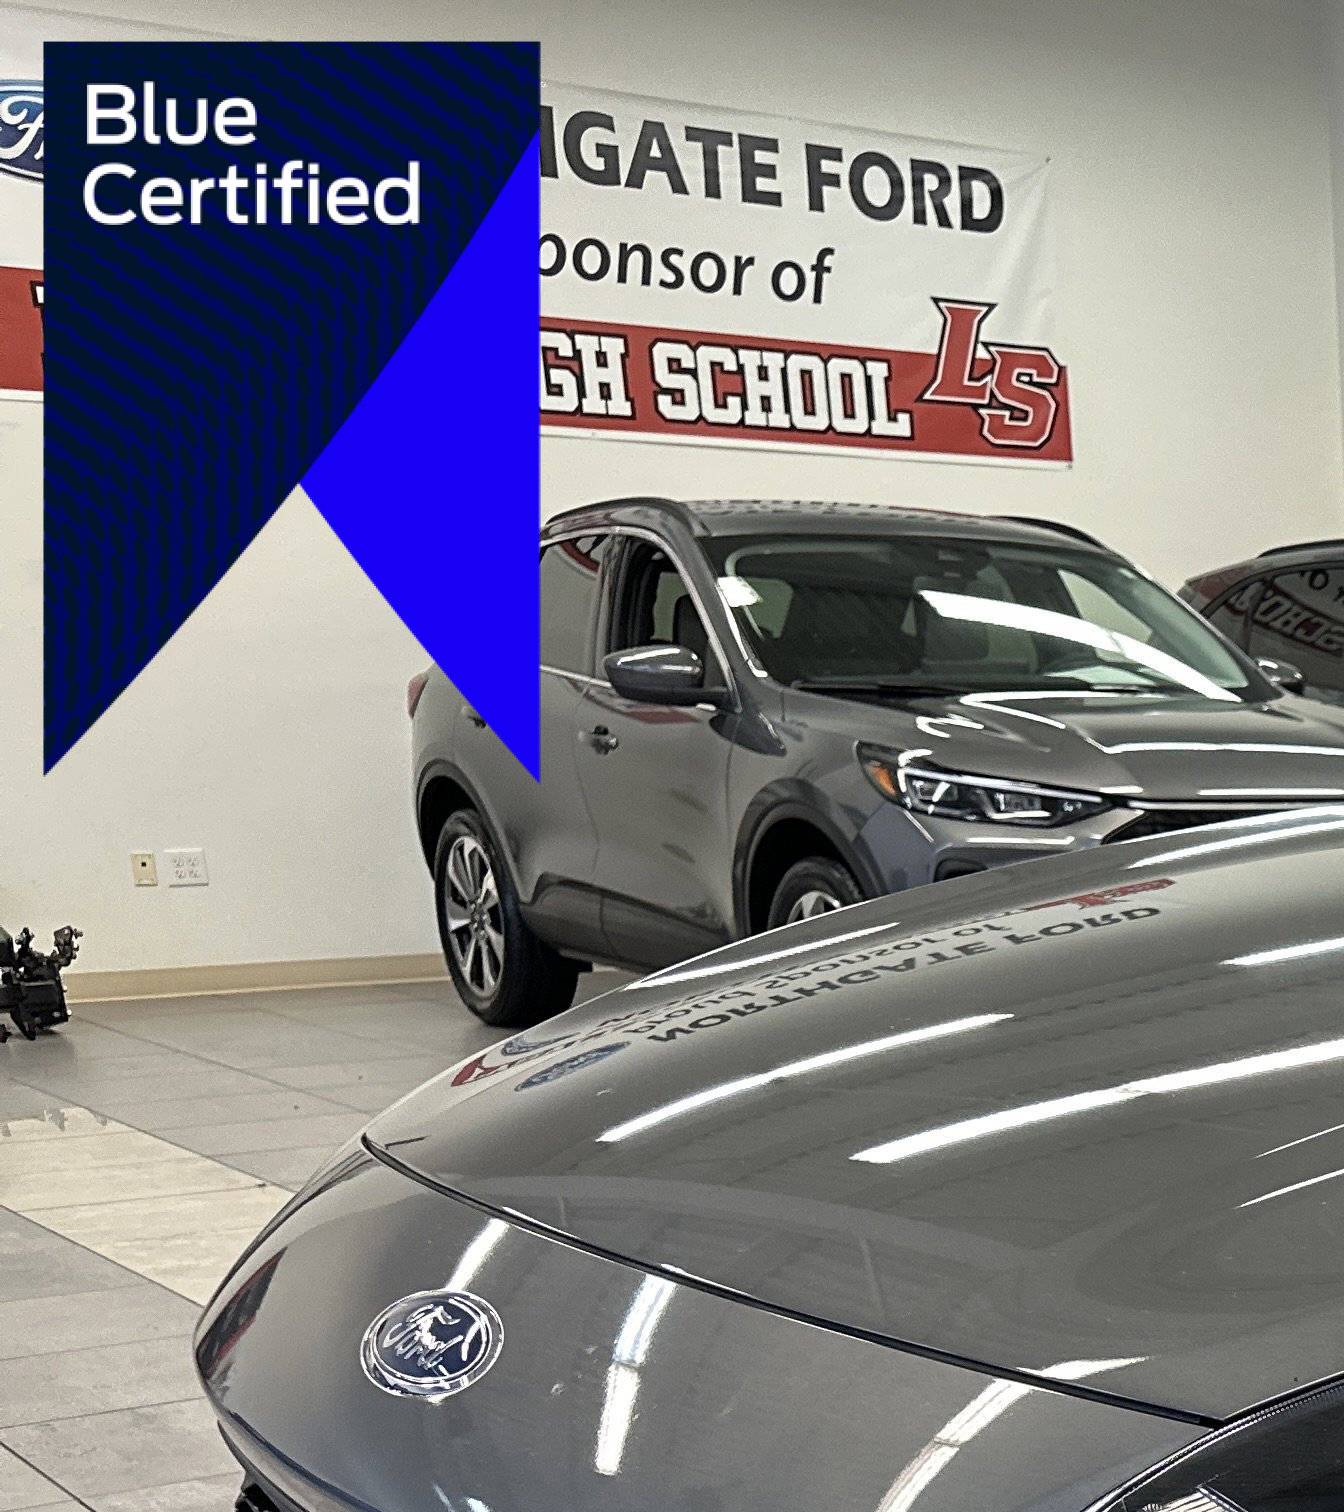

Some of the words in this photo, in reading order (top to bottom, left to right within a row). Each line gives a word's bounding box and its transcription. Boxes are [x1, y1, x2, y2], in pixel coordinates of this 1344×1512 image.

[804, 143, 1004, 235] FORD
[771, 246, 835, 304] of
[540, 329, 633, 418] GH
[650, 338, 914, 439] SCHOOL
